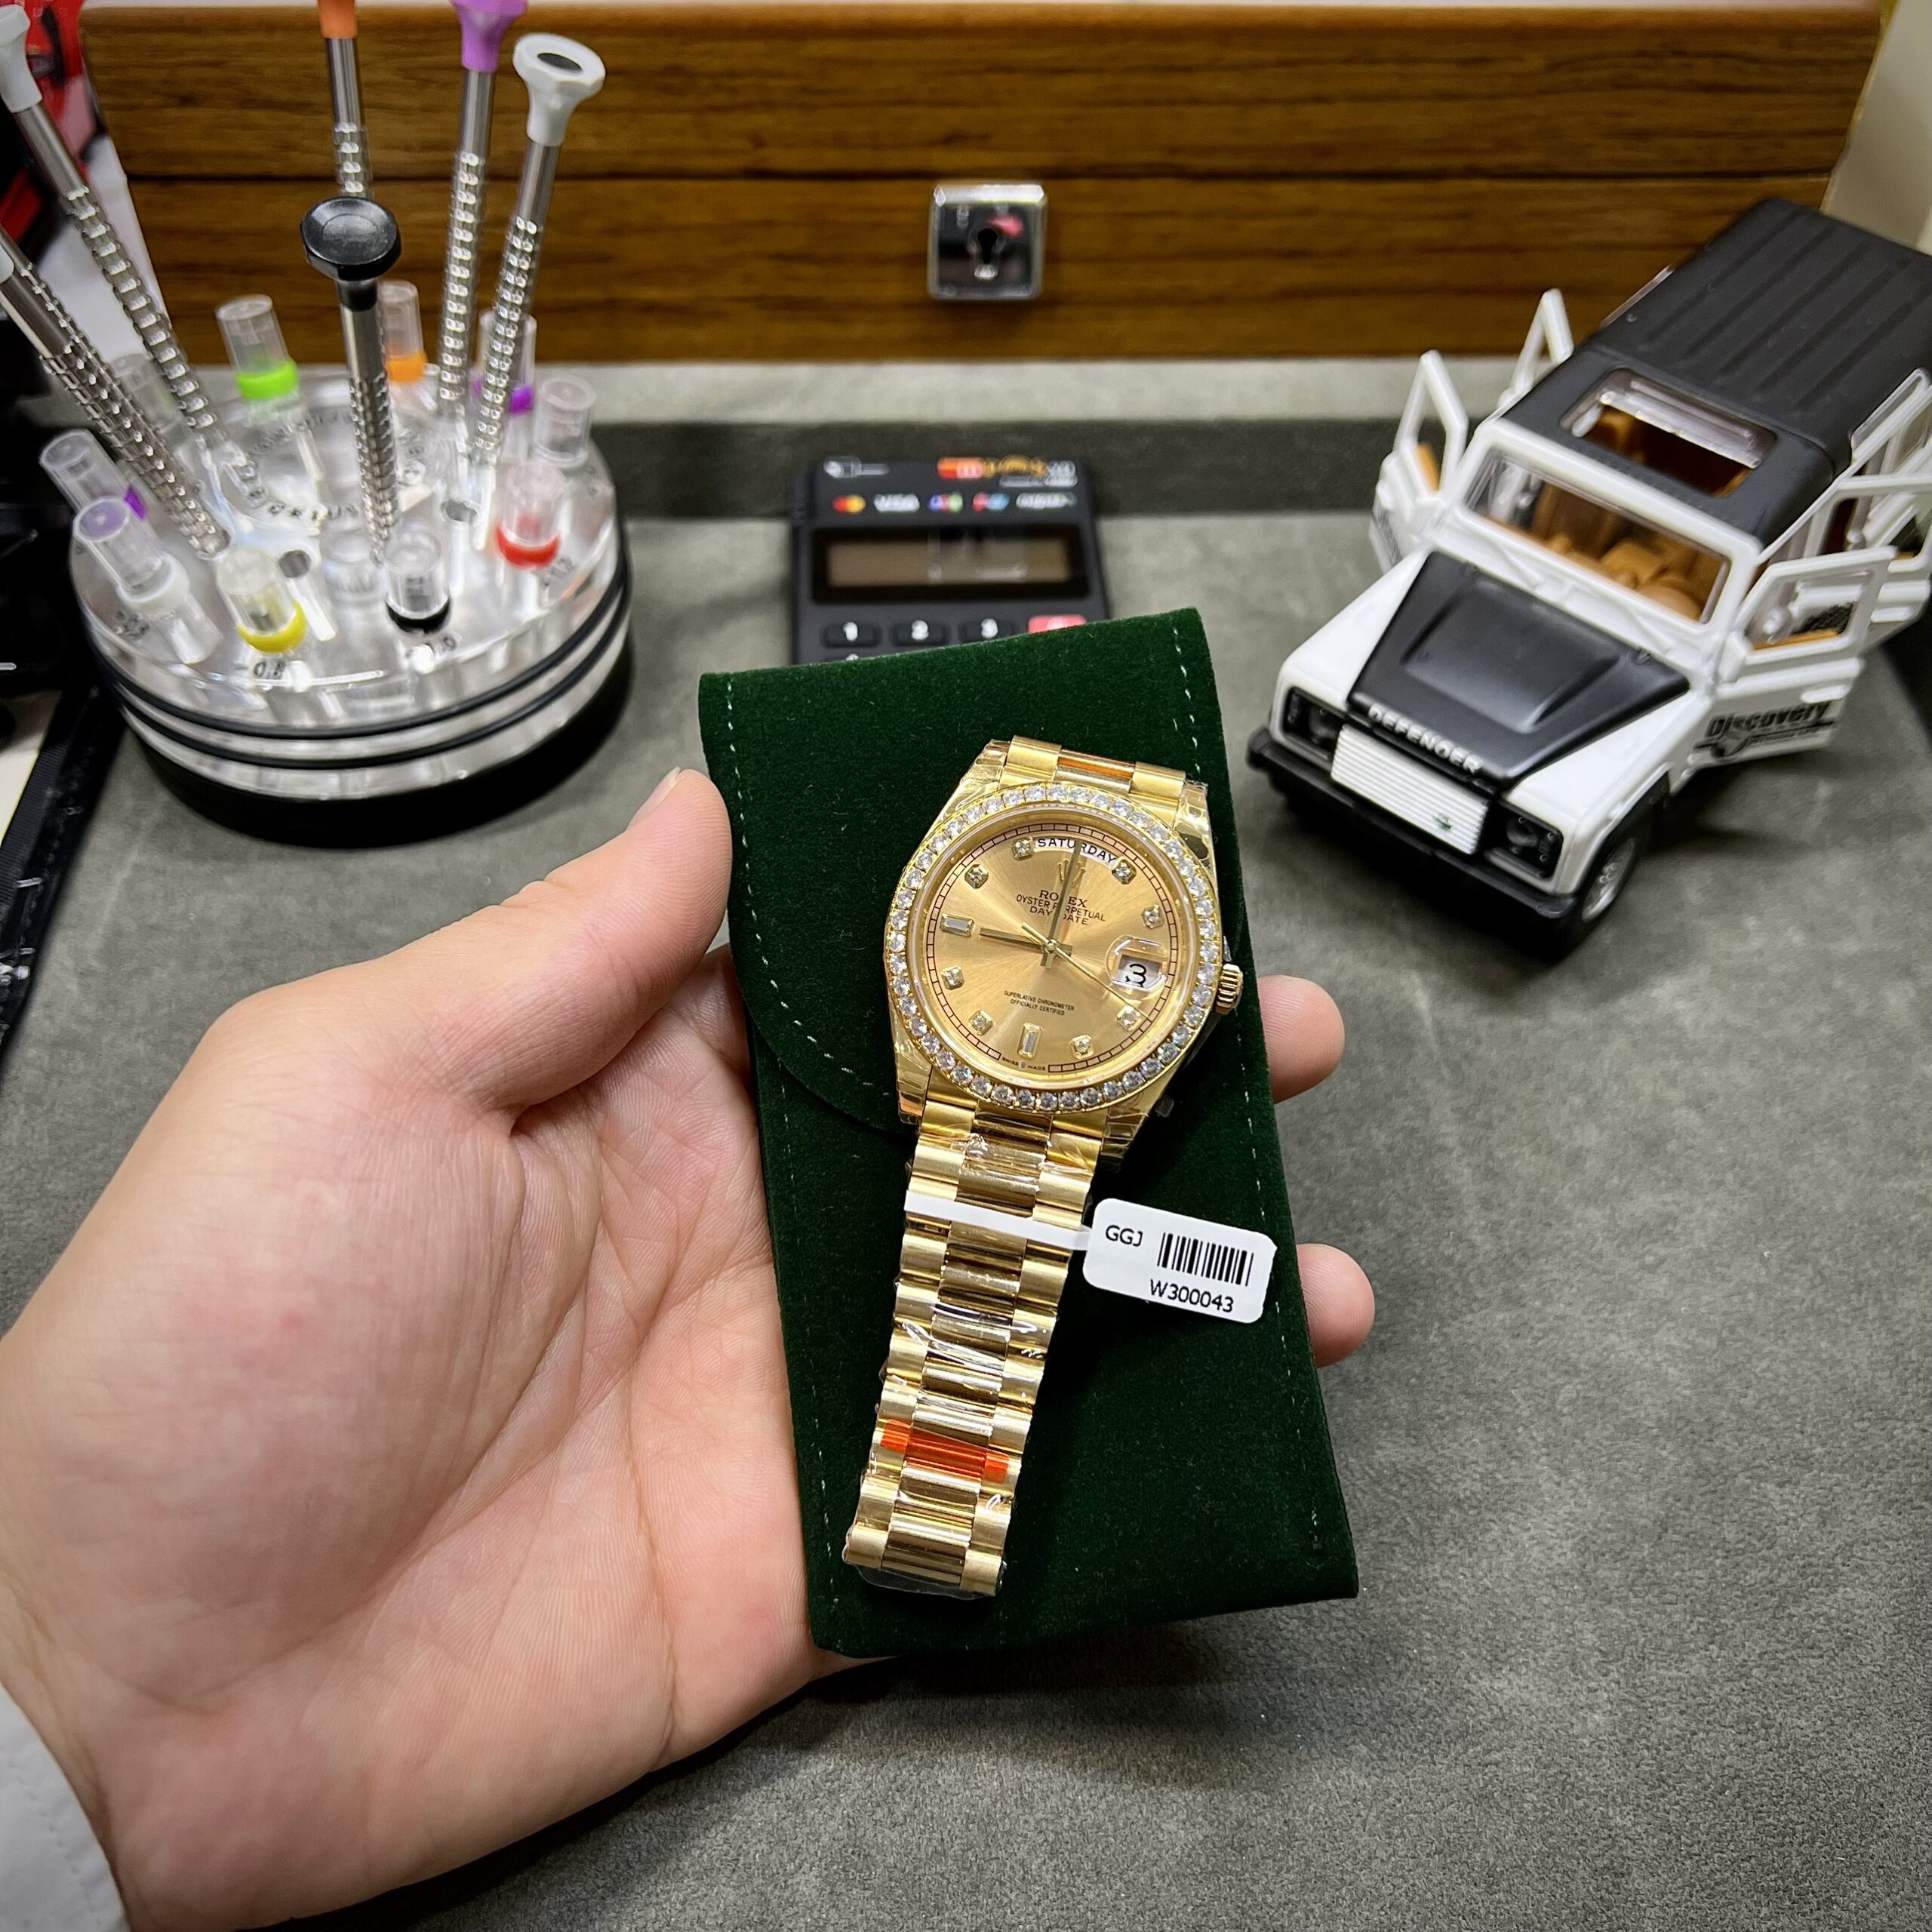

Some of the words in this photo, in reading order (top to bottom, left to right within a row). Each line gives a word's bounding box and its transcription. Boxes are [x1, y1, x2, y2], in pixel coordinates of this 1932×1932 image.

[1367, 702, 1484, 775] DEFENDER
[1038, 838, 1118, 864] SATURDAY
[1016, 894, 1051, 908] OYSTER
[1053, 902, 1106, 921] PRPETUAL
[1038, 889, 1088, 909] ROEX
[1125, 963, 1147, 988] 3
[1003, 989, 1037, 1003] SUPERLATIVE
[1037, 997, 1075, 1011] CHRONOMETER
[1010, 998, 1038, 1010] OFFICIALLY
[1038, 1005, 1066, 1016] CERTIFIED
[1001, 1057, 1020, 1066] SWISS
[1105, 1225, 1144, 1247] GGJ
[1150, 1278, 1235, 1313] W300043
